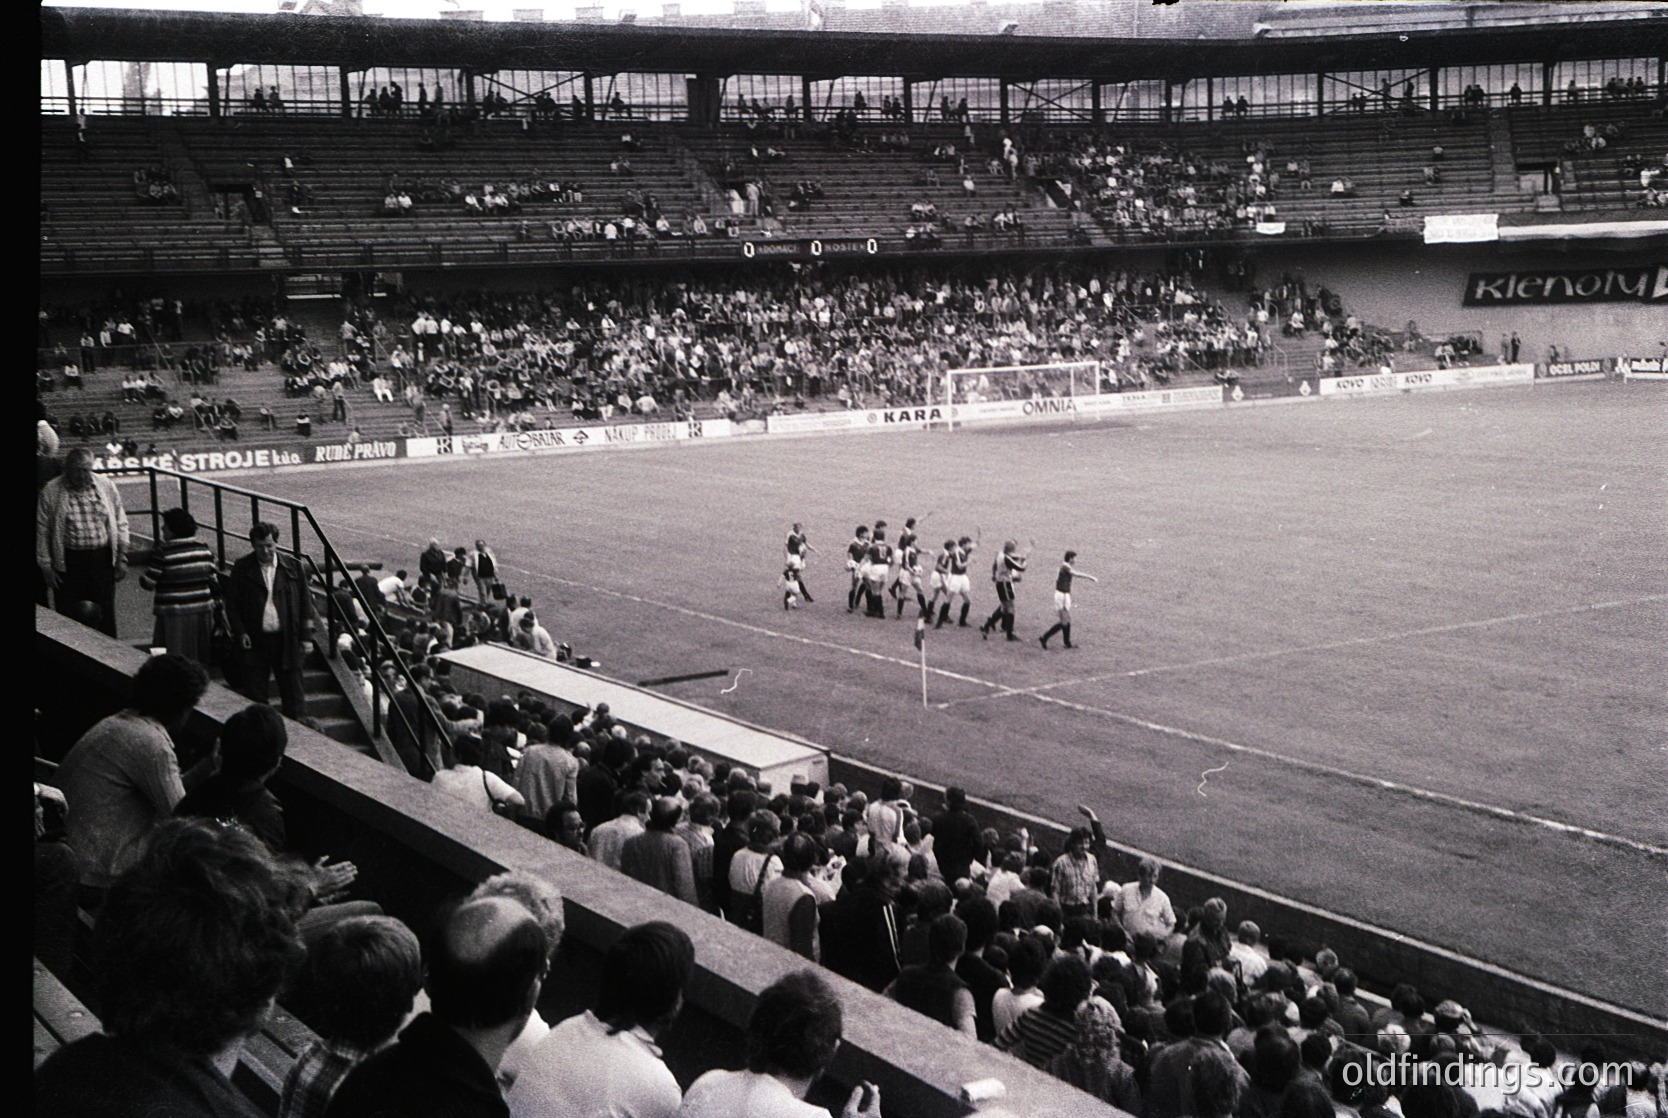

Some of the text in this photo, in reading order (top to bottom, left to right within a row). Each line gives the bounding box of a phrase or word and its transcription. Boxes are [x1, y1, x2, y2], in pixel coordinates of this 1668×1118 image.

[744, 242, 755, 258] 0
[811, 240, 822, 256] 0
[867, 238, 878, 254] 0
[883, 407, 942, 423] KARA
[1022, 398, 1077, 415] OMNIA
[181, 449, 270, 472] STROJE
[314, 440, 397, 462] RUDÉ PRÁVO
